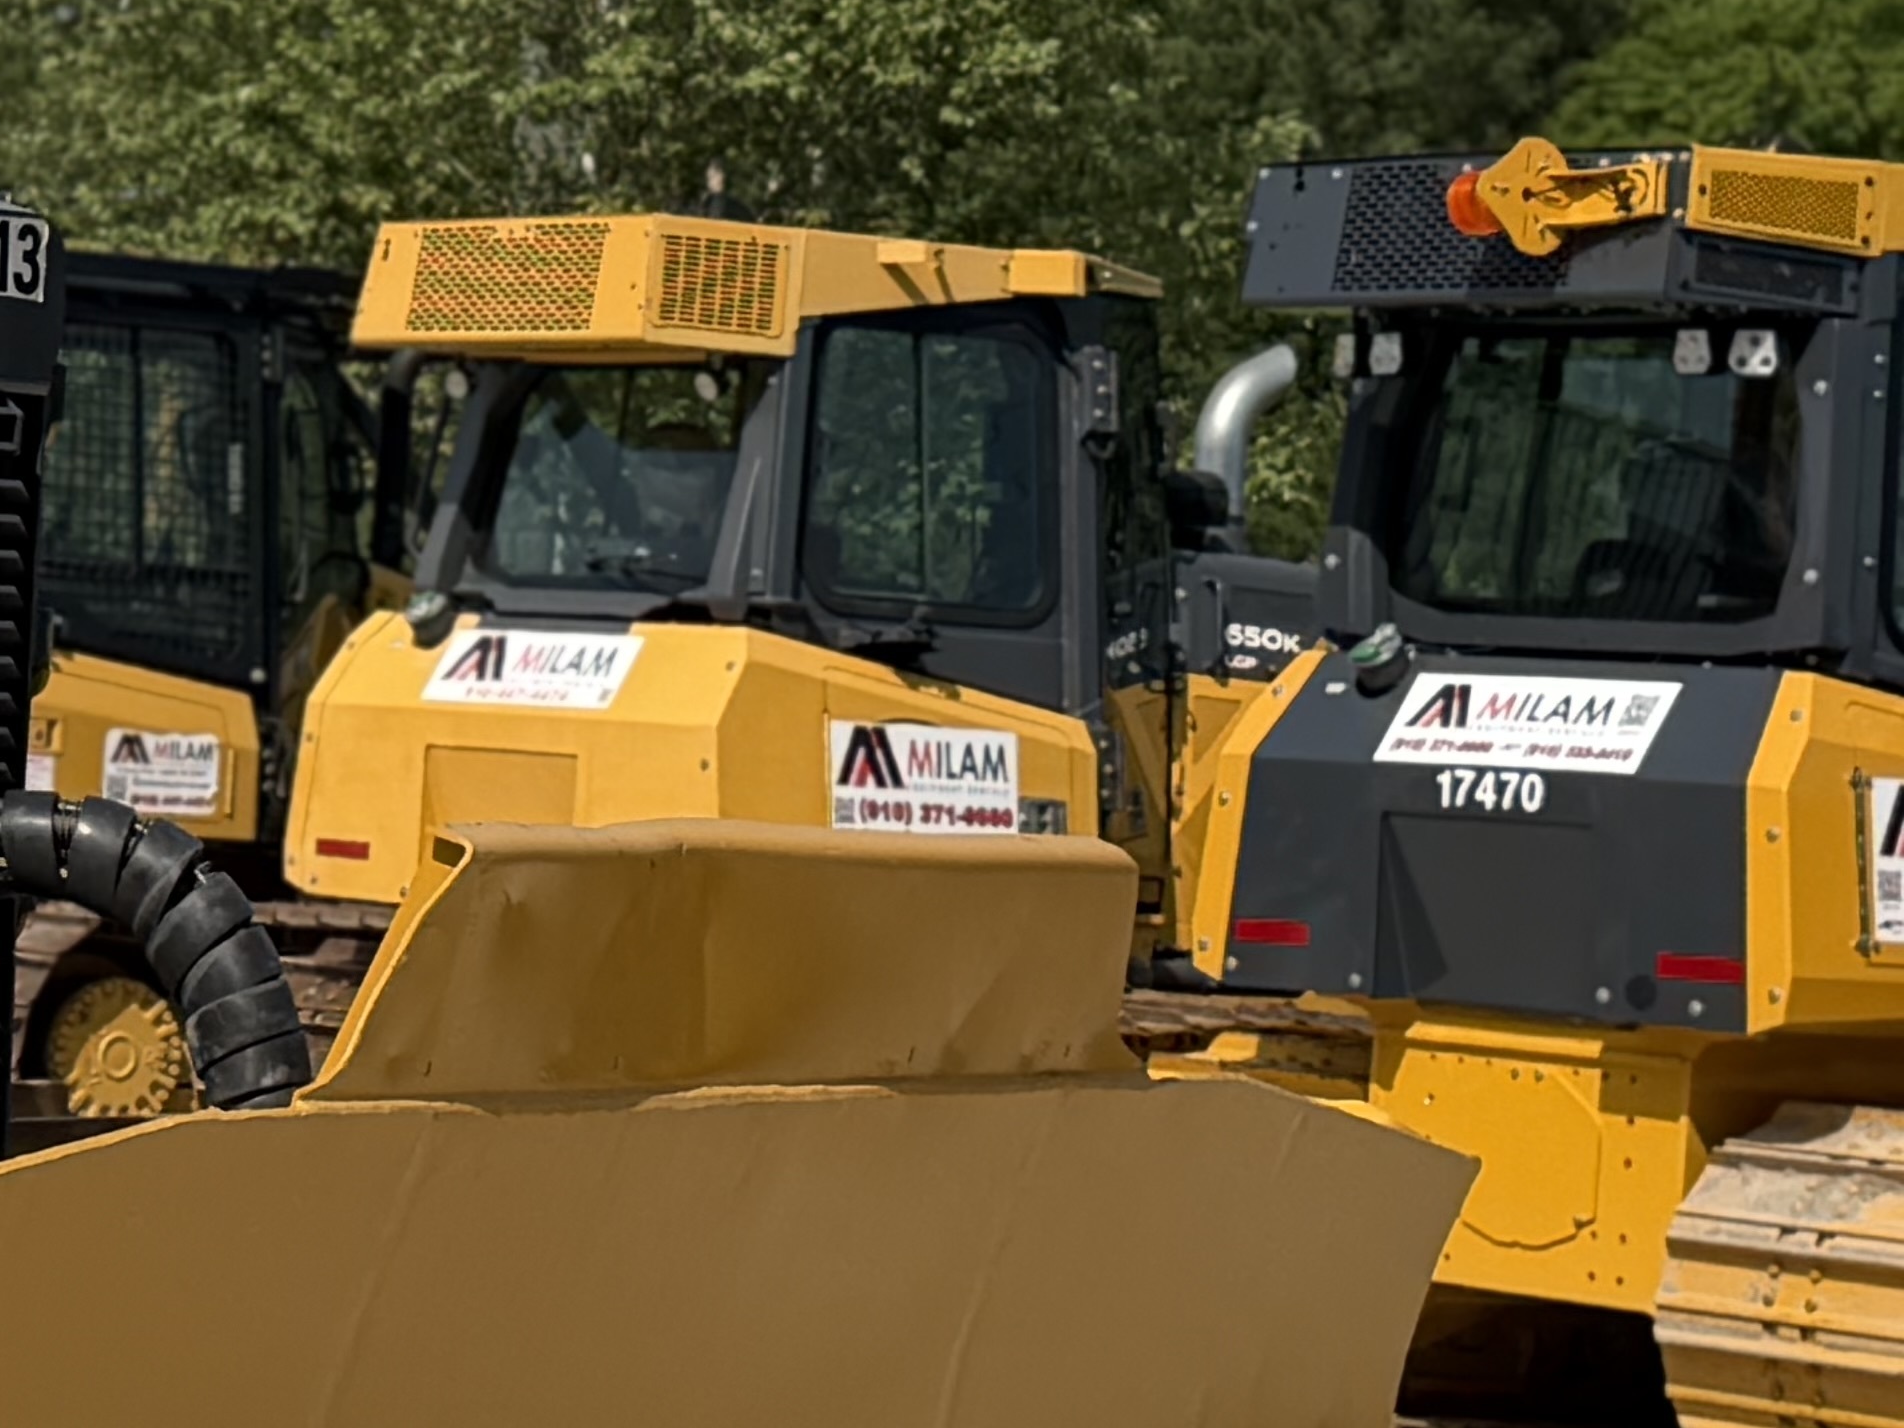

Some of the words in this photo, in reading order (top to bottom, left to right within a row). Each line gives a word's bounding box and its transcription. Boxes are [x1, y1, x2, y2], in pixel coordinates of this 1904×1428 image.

[511, 644, 619, 677] MILAM
[1476, 692, 1616, 726] MILAM
[154, 740, 214, 761] MILAM
[907, 738, 1010, 783] MILAM
[1435, 769, 1545, 813] 17470
